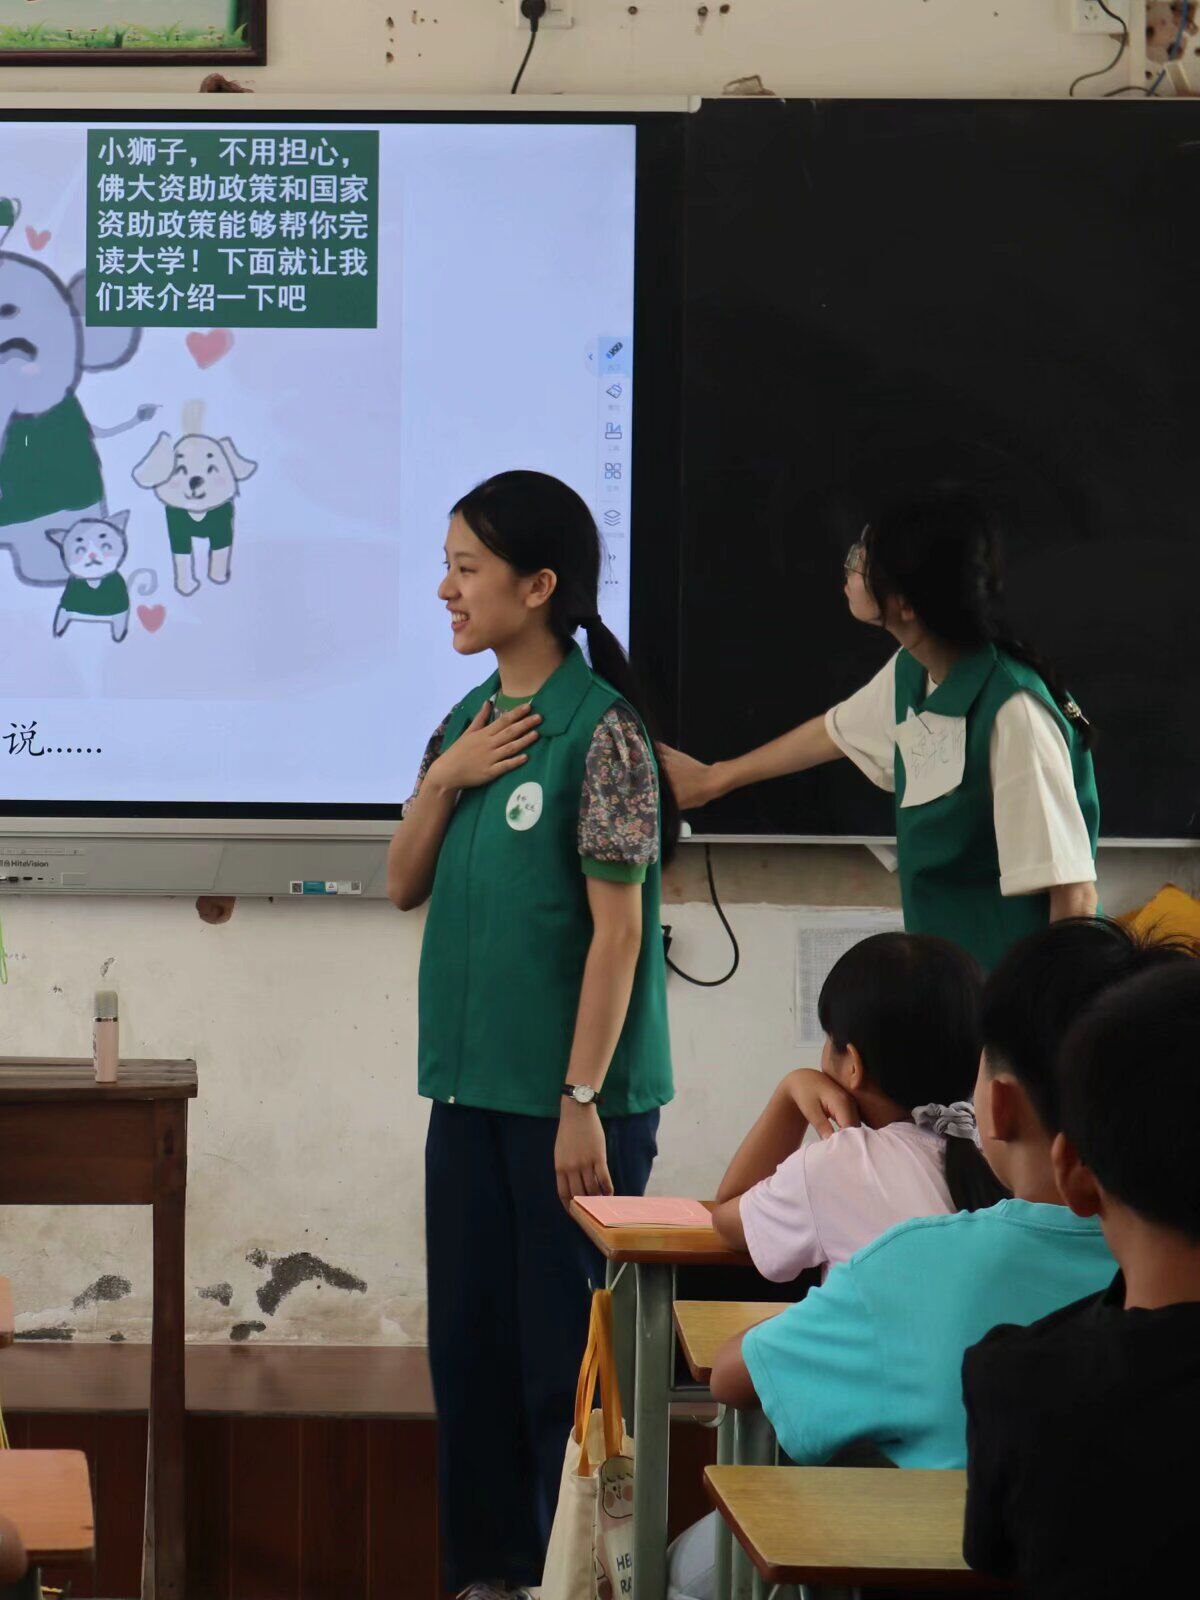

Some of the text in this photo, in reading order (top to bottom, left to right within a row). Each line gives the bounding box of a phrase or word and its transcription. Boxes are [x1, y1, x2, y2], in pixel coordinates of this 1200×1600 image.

[97, 136, 351, 168] 小狮子，不用担心，
[96, 173, 369, 204] 佛大资助政策和国家
[96, 209, 369, 240] 资助政策能够帮你完
[95, 245, 369, 276] 读大学！下面就让我
[95, 281, 307, 312] 们来介绍一下吧
